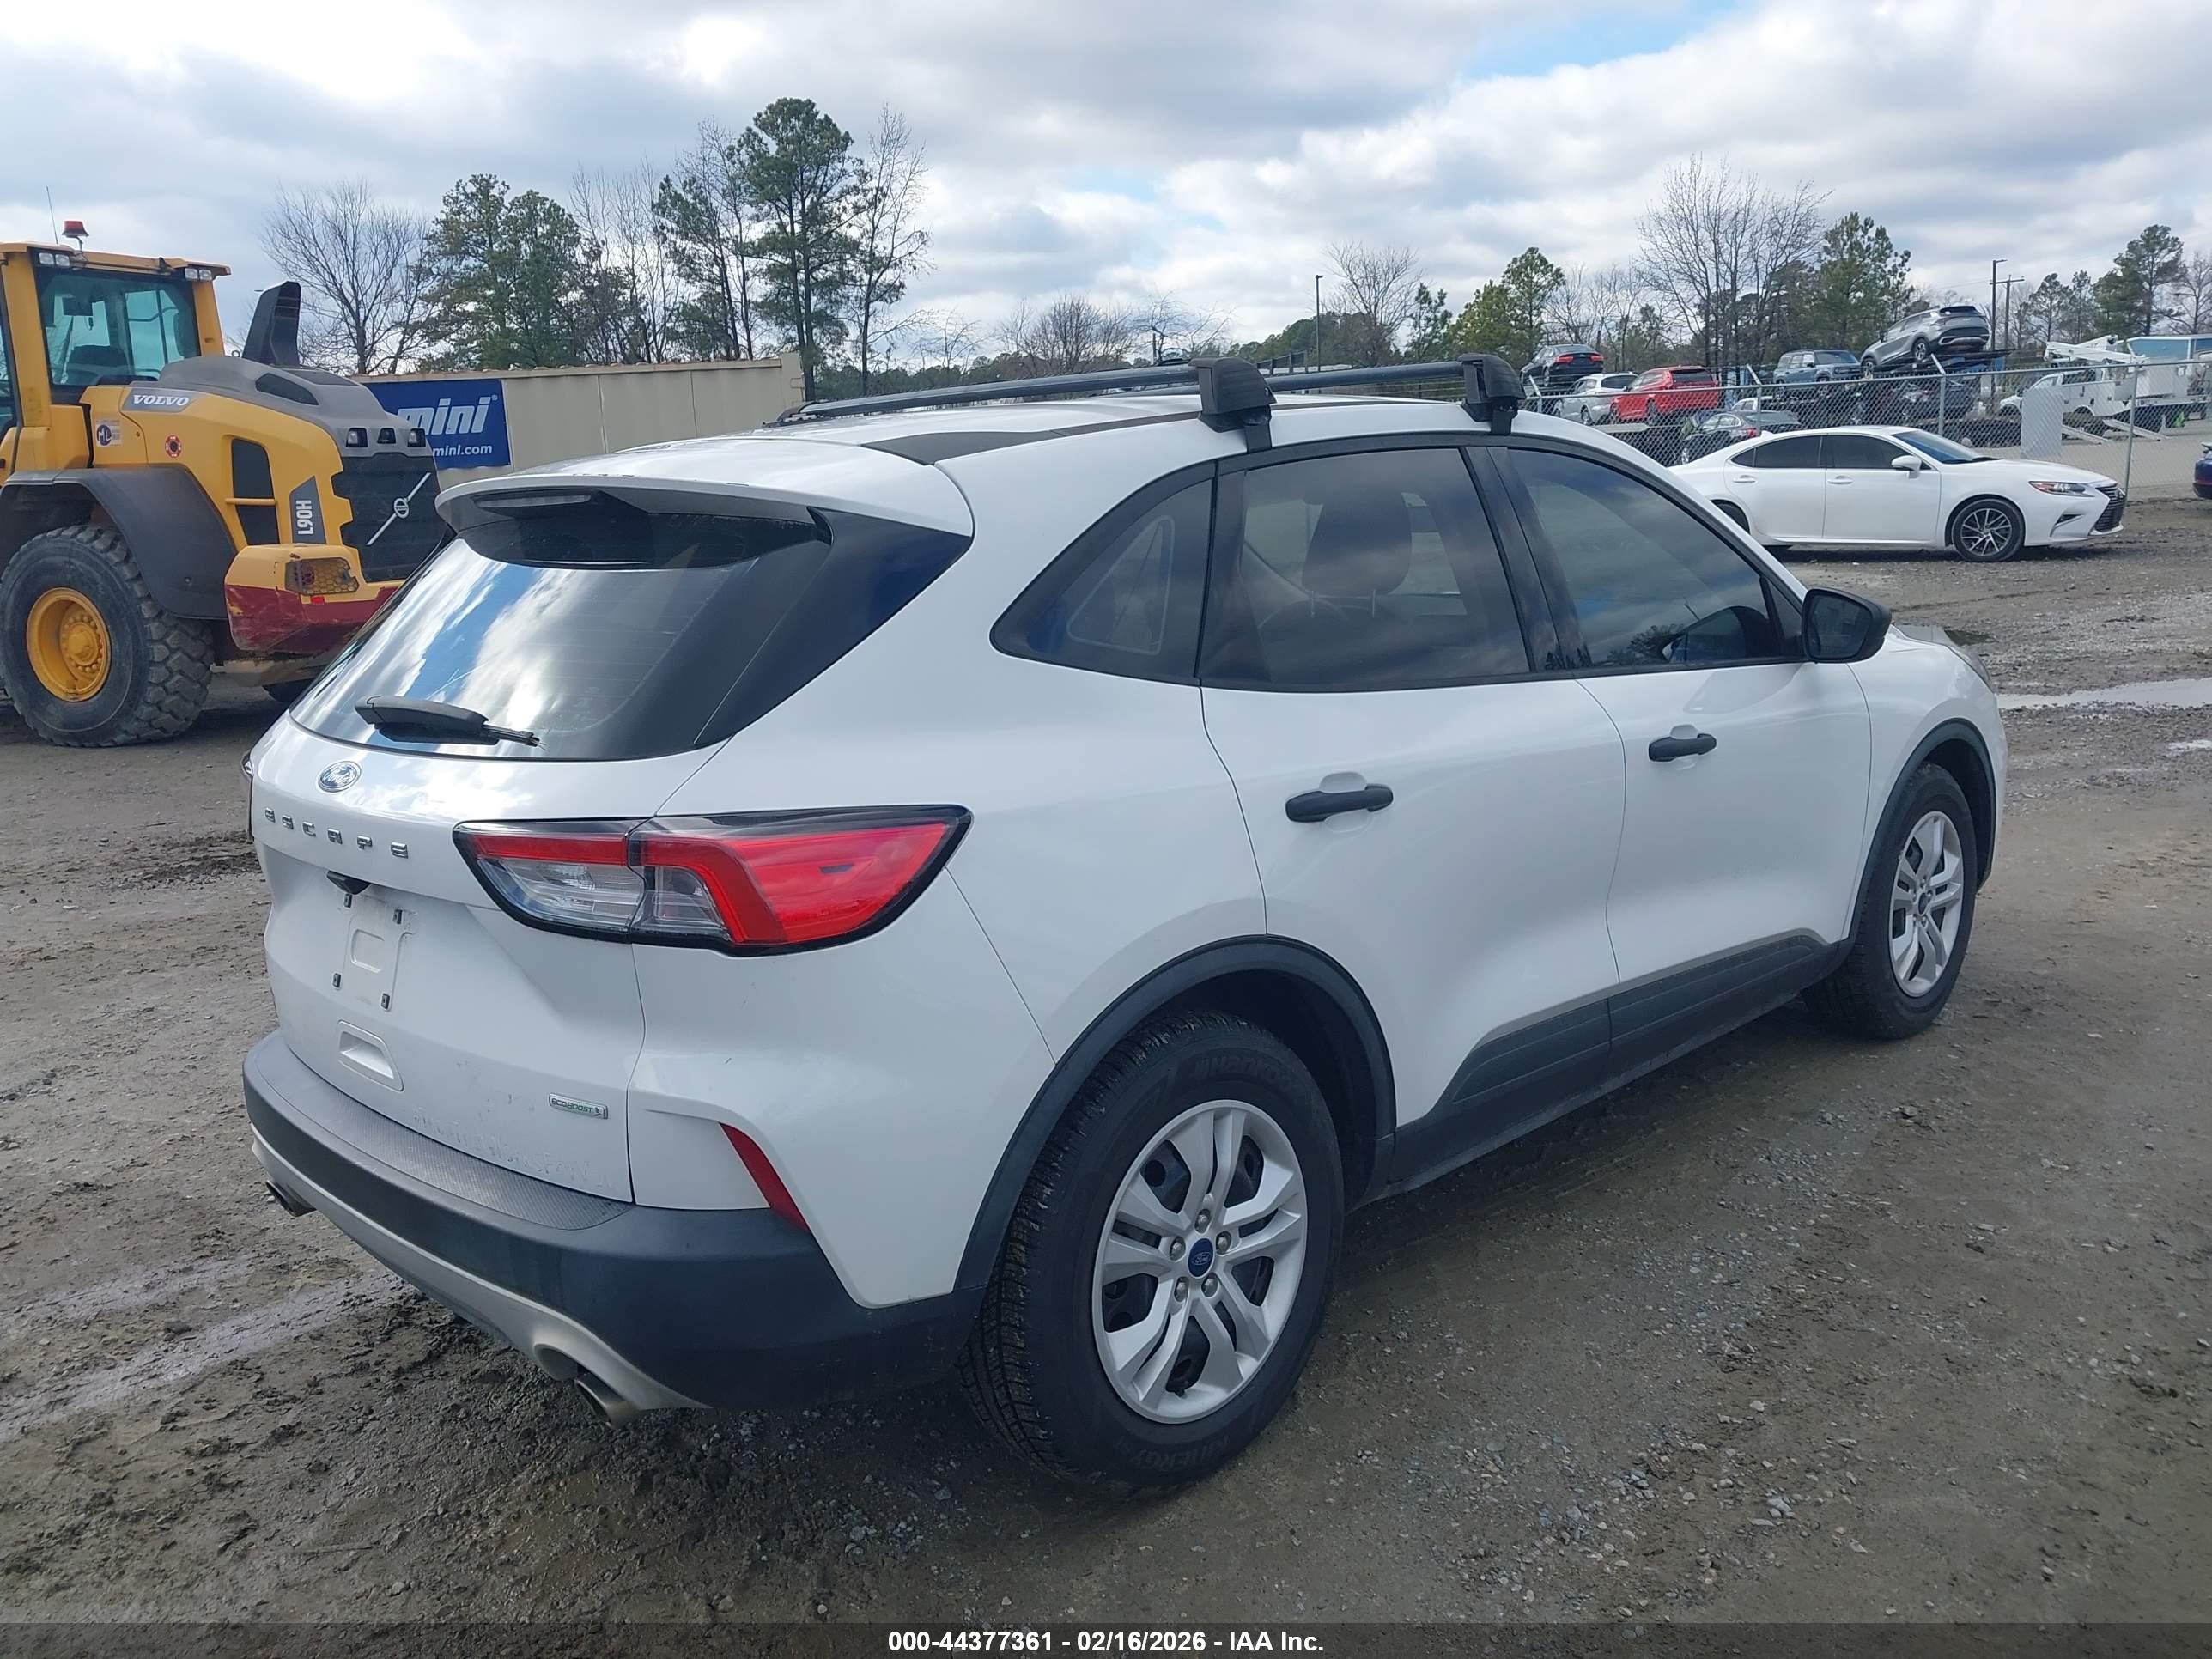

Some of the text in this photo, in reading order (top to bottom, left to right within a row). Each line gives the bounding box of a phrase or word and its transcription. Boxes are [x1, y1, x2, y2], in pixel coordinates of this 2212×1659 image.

[133, 394, 189, 406] VOLVO
[295, 500, 314, 535] L90H
[264, 807, 409, 859] ESCAPE
[551, 1097, 594, 1114] ECOBOOST
